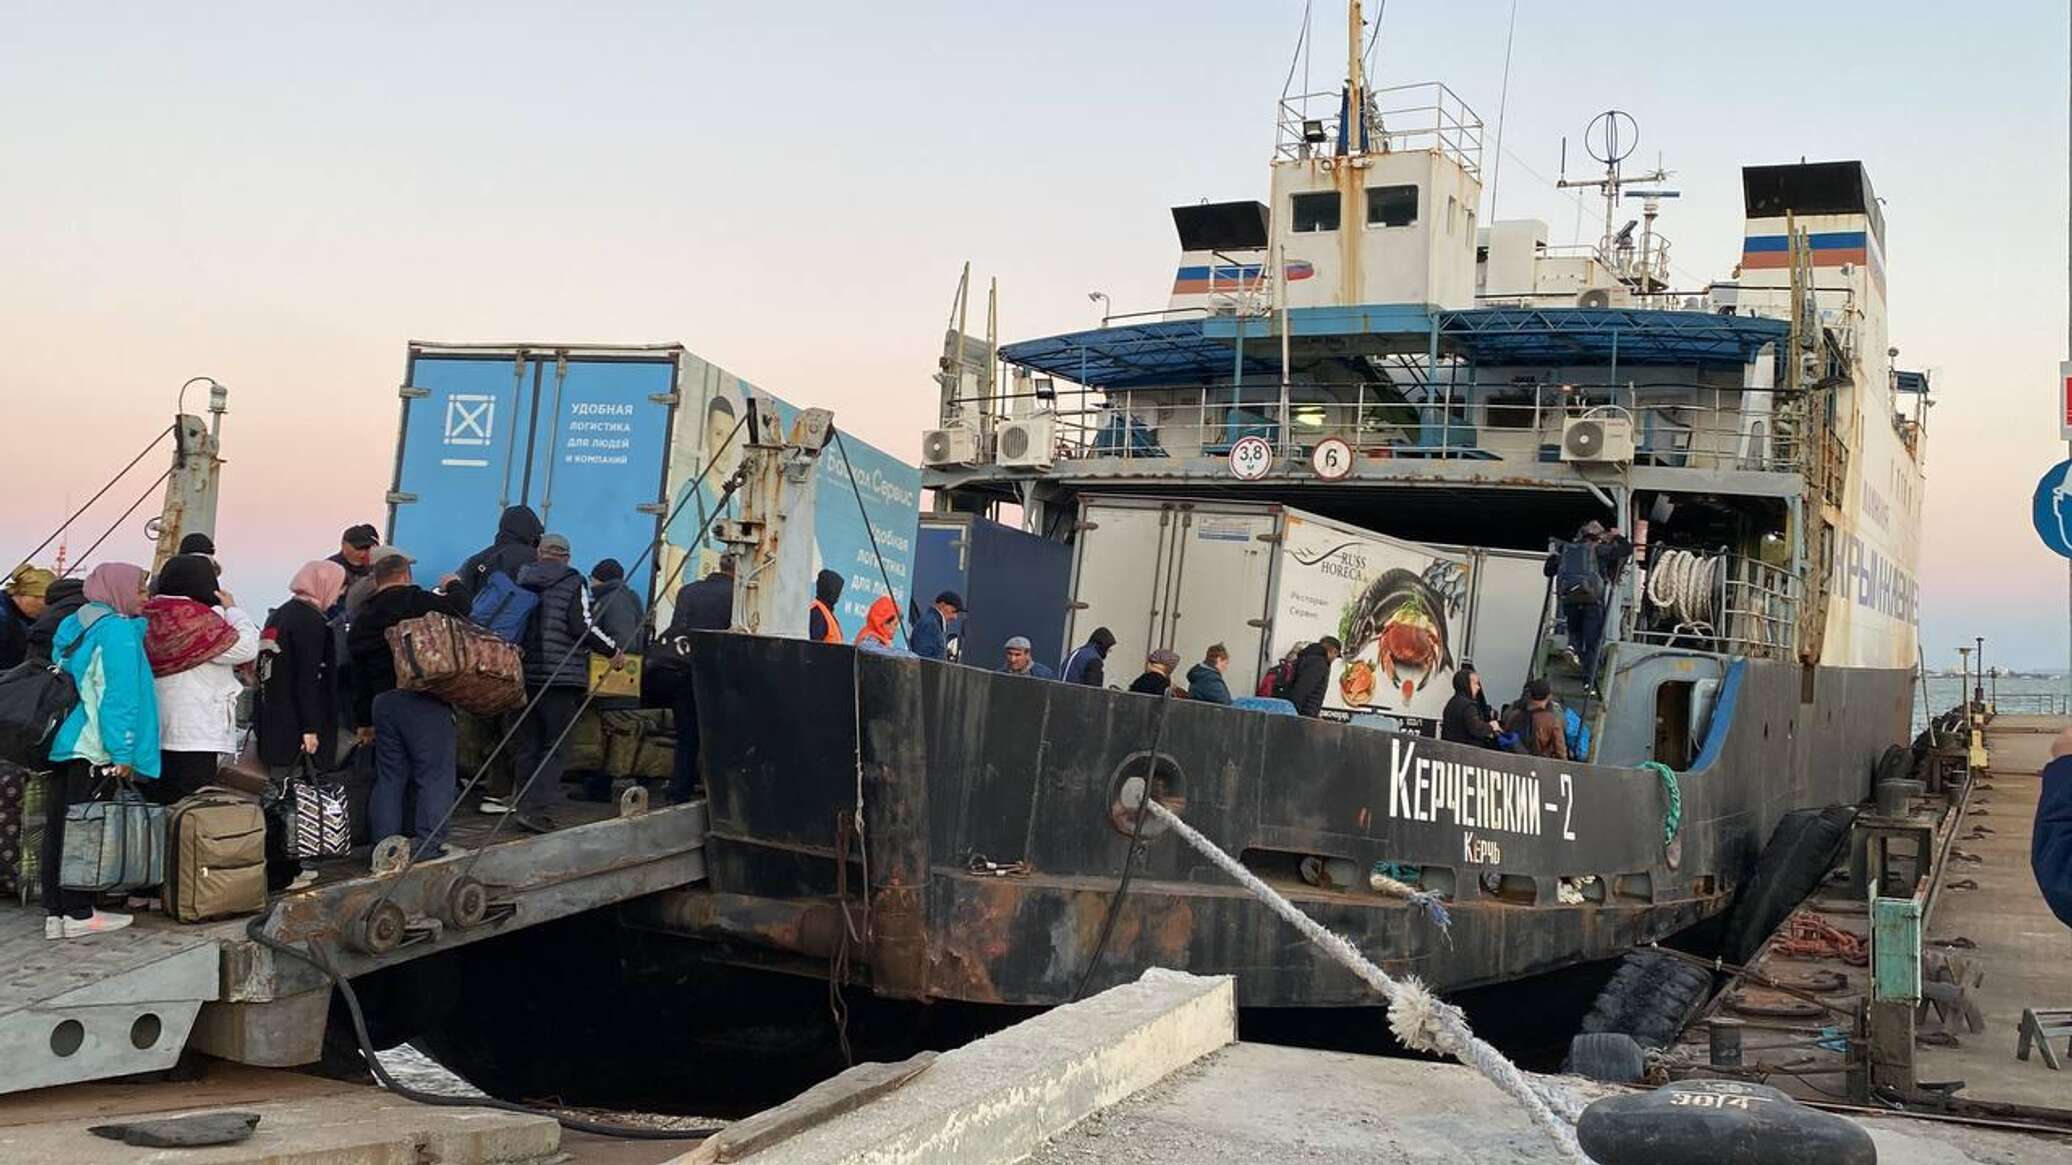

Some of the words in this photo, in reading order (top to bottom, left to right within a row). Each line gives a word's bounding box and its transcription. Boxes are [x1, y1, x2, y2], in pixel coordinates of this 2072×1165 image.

[571, 403, 633, 415] УДОБНАЯ
[569, 421, 631, 432] ЛОГИСТИКА
[567, 438, 589, 448] ДЛЯ
[592, 438, 630, 450] ЛЮДЕЙ
[1240, 445, 1263, 464] 3,8
[1325, 448, 1338, 468] 6
[1341, 552, 1367, 569] RUSS
[1321, 561, 1362, 581] HORECA
